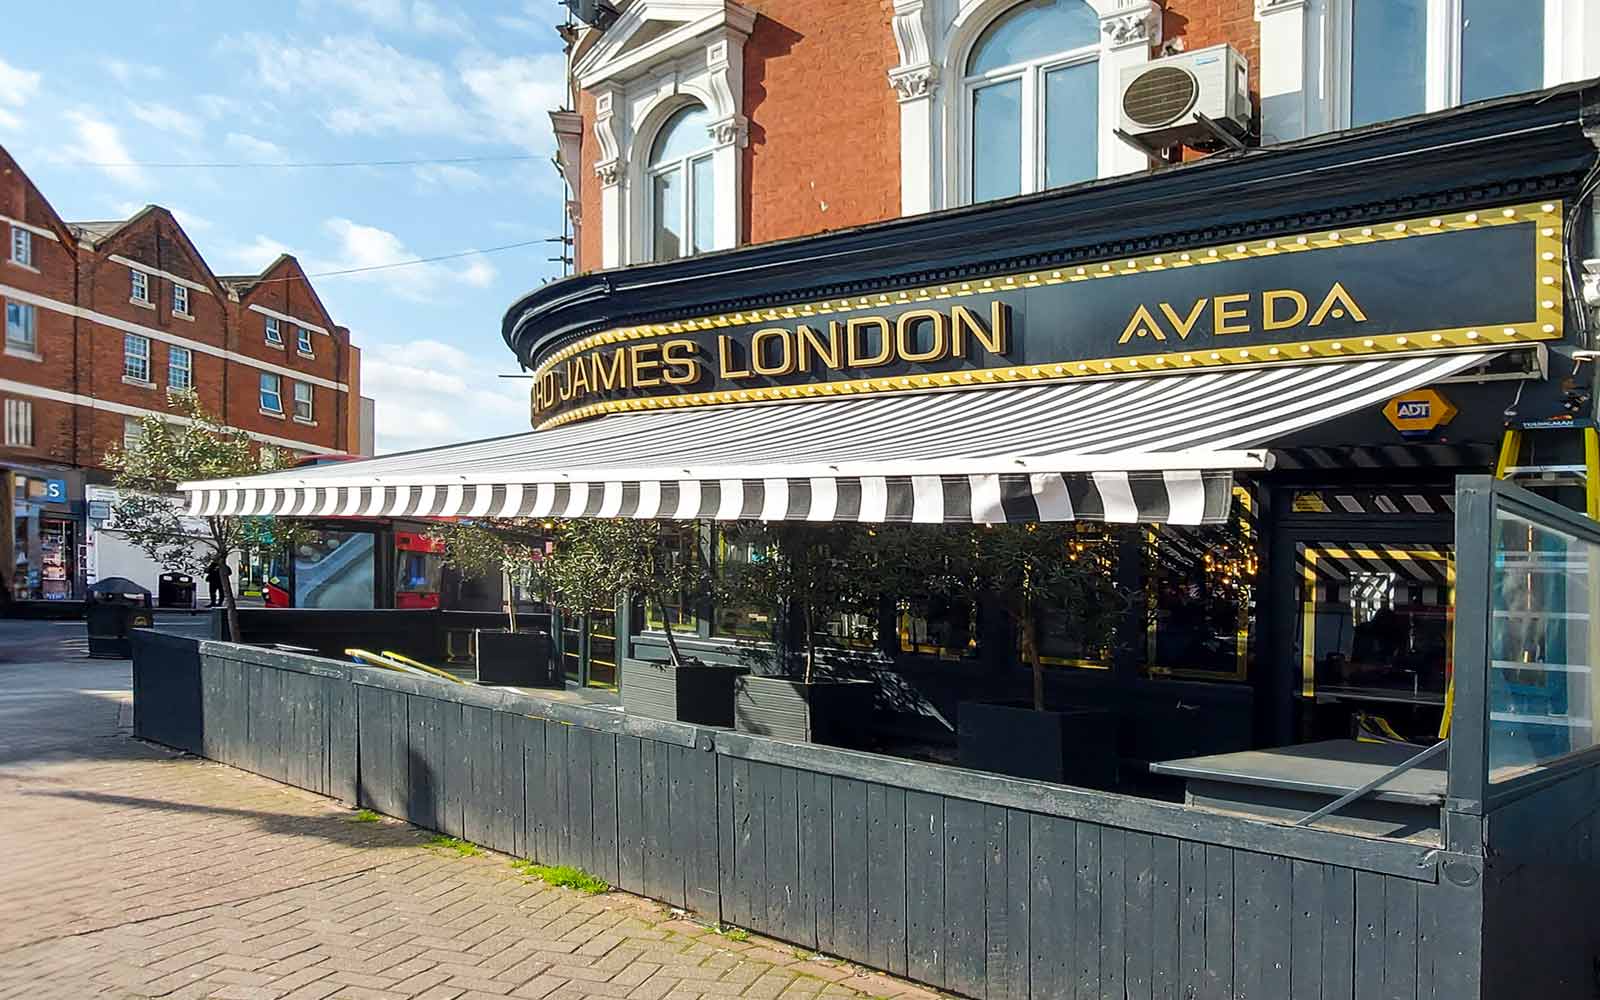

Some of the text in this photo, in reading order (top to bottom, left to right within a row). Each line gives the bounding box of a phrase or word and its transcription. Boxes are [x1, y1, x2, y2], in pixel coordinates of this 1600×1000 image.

[1118, 282, 1368, 344] AVEDA
[532, 300, 1005, 413] RD JAMES LONDON
[1398, 403, 1430, 416] ADT
